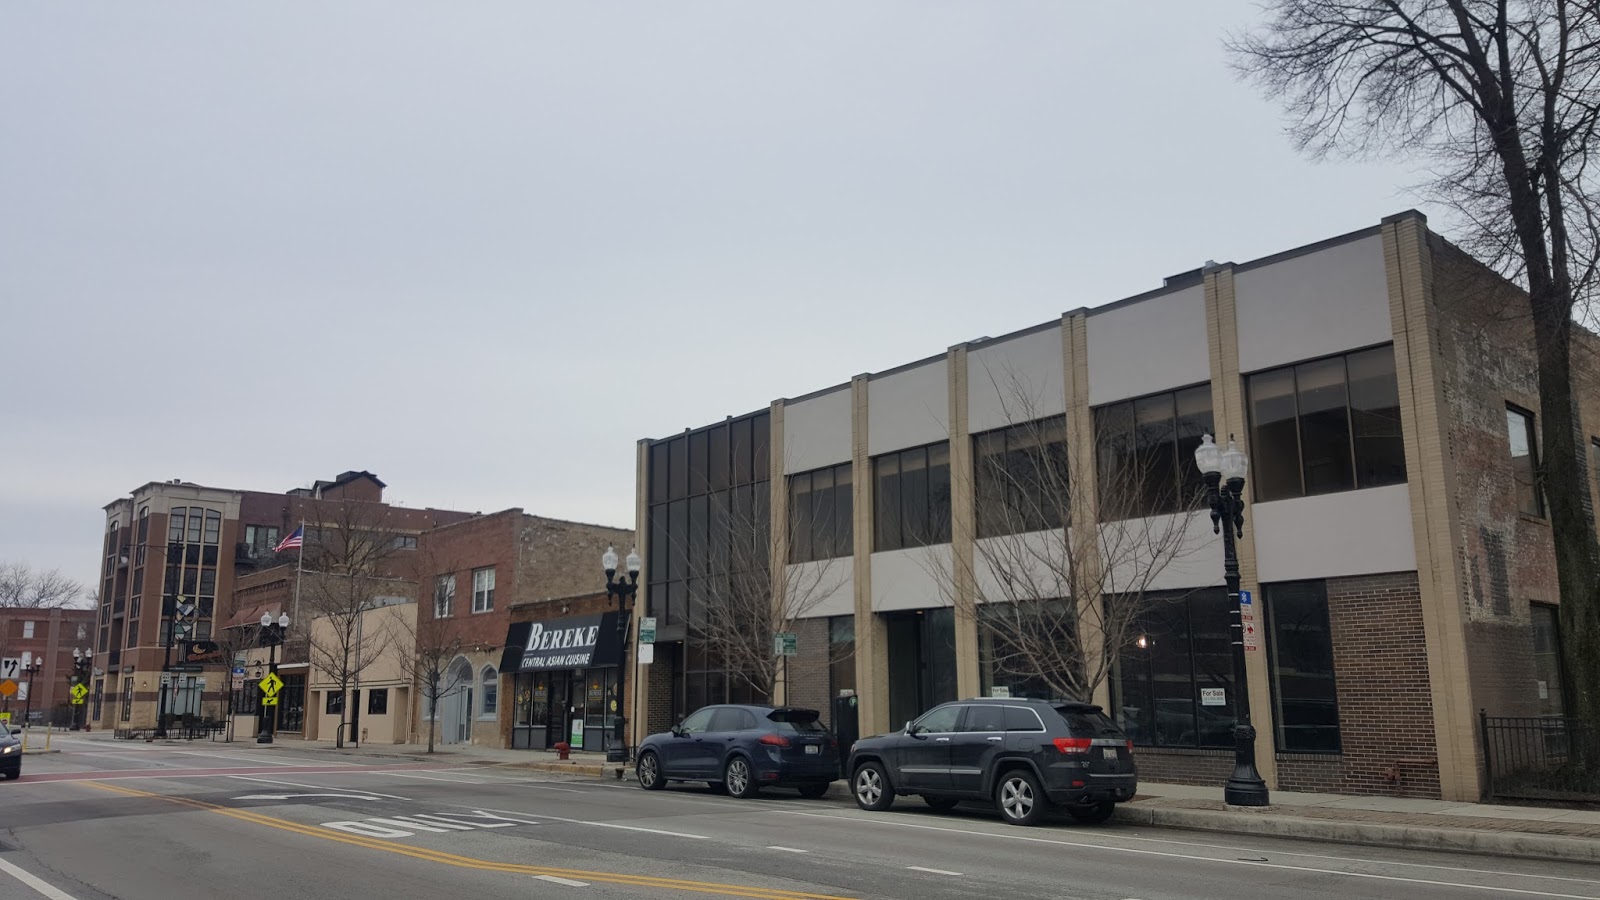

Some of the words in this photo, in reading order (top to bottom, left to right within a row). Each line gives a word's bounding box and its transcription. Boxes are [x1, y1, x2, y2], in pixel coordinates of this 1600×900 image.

[526, 623, 599, 651] BEREKE
[522, 656, 545, 668] CENTRAL
[546, 655, 565, 667] ASIAN
[565, 653, 590, 666] CUISINE
[320, 810, 540, 838] ONLY
